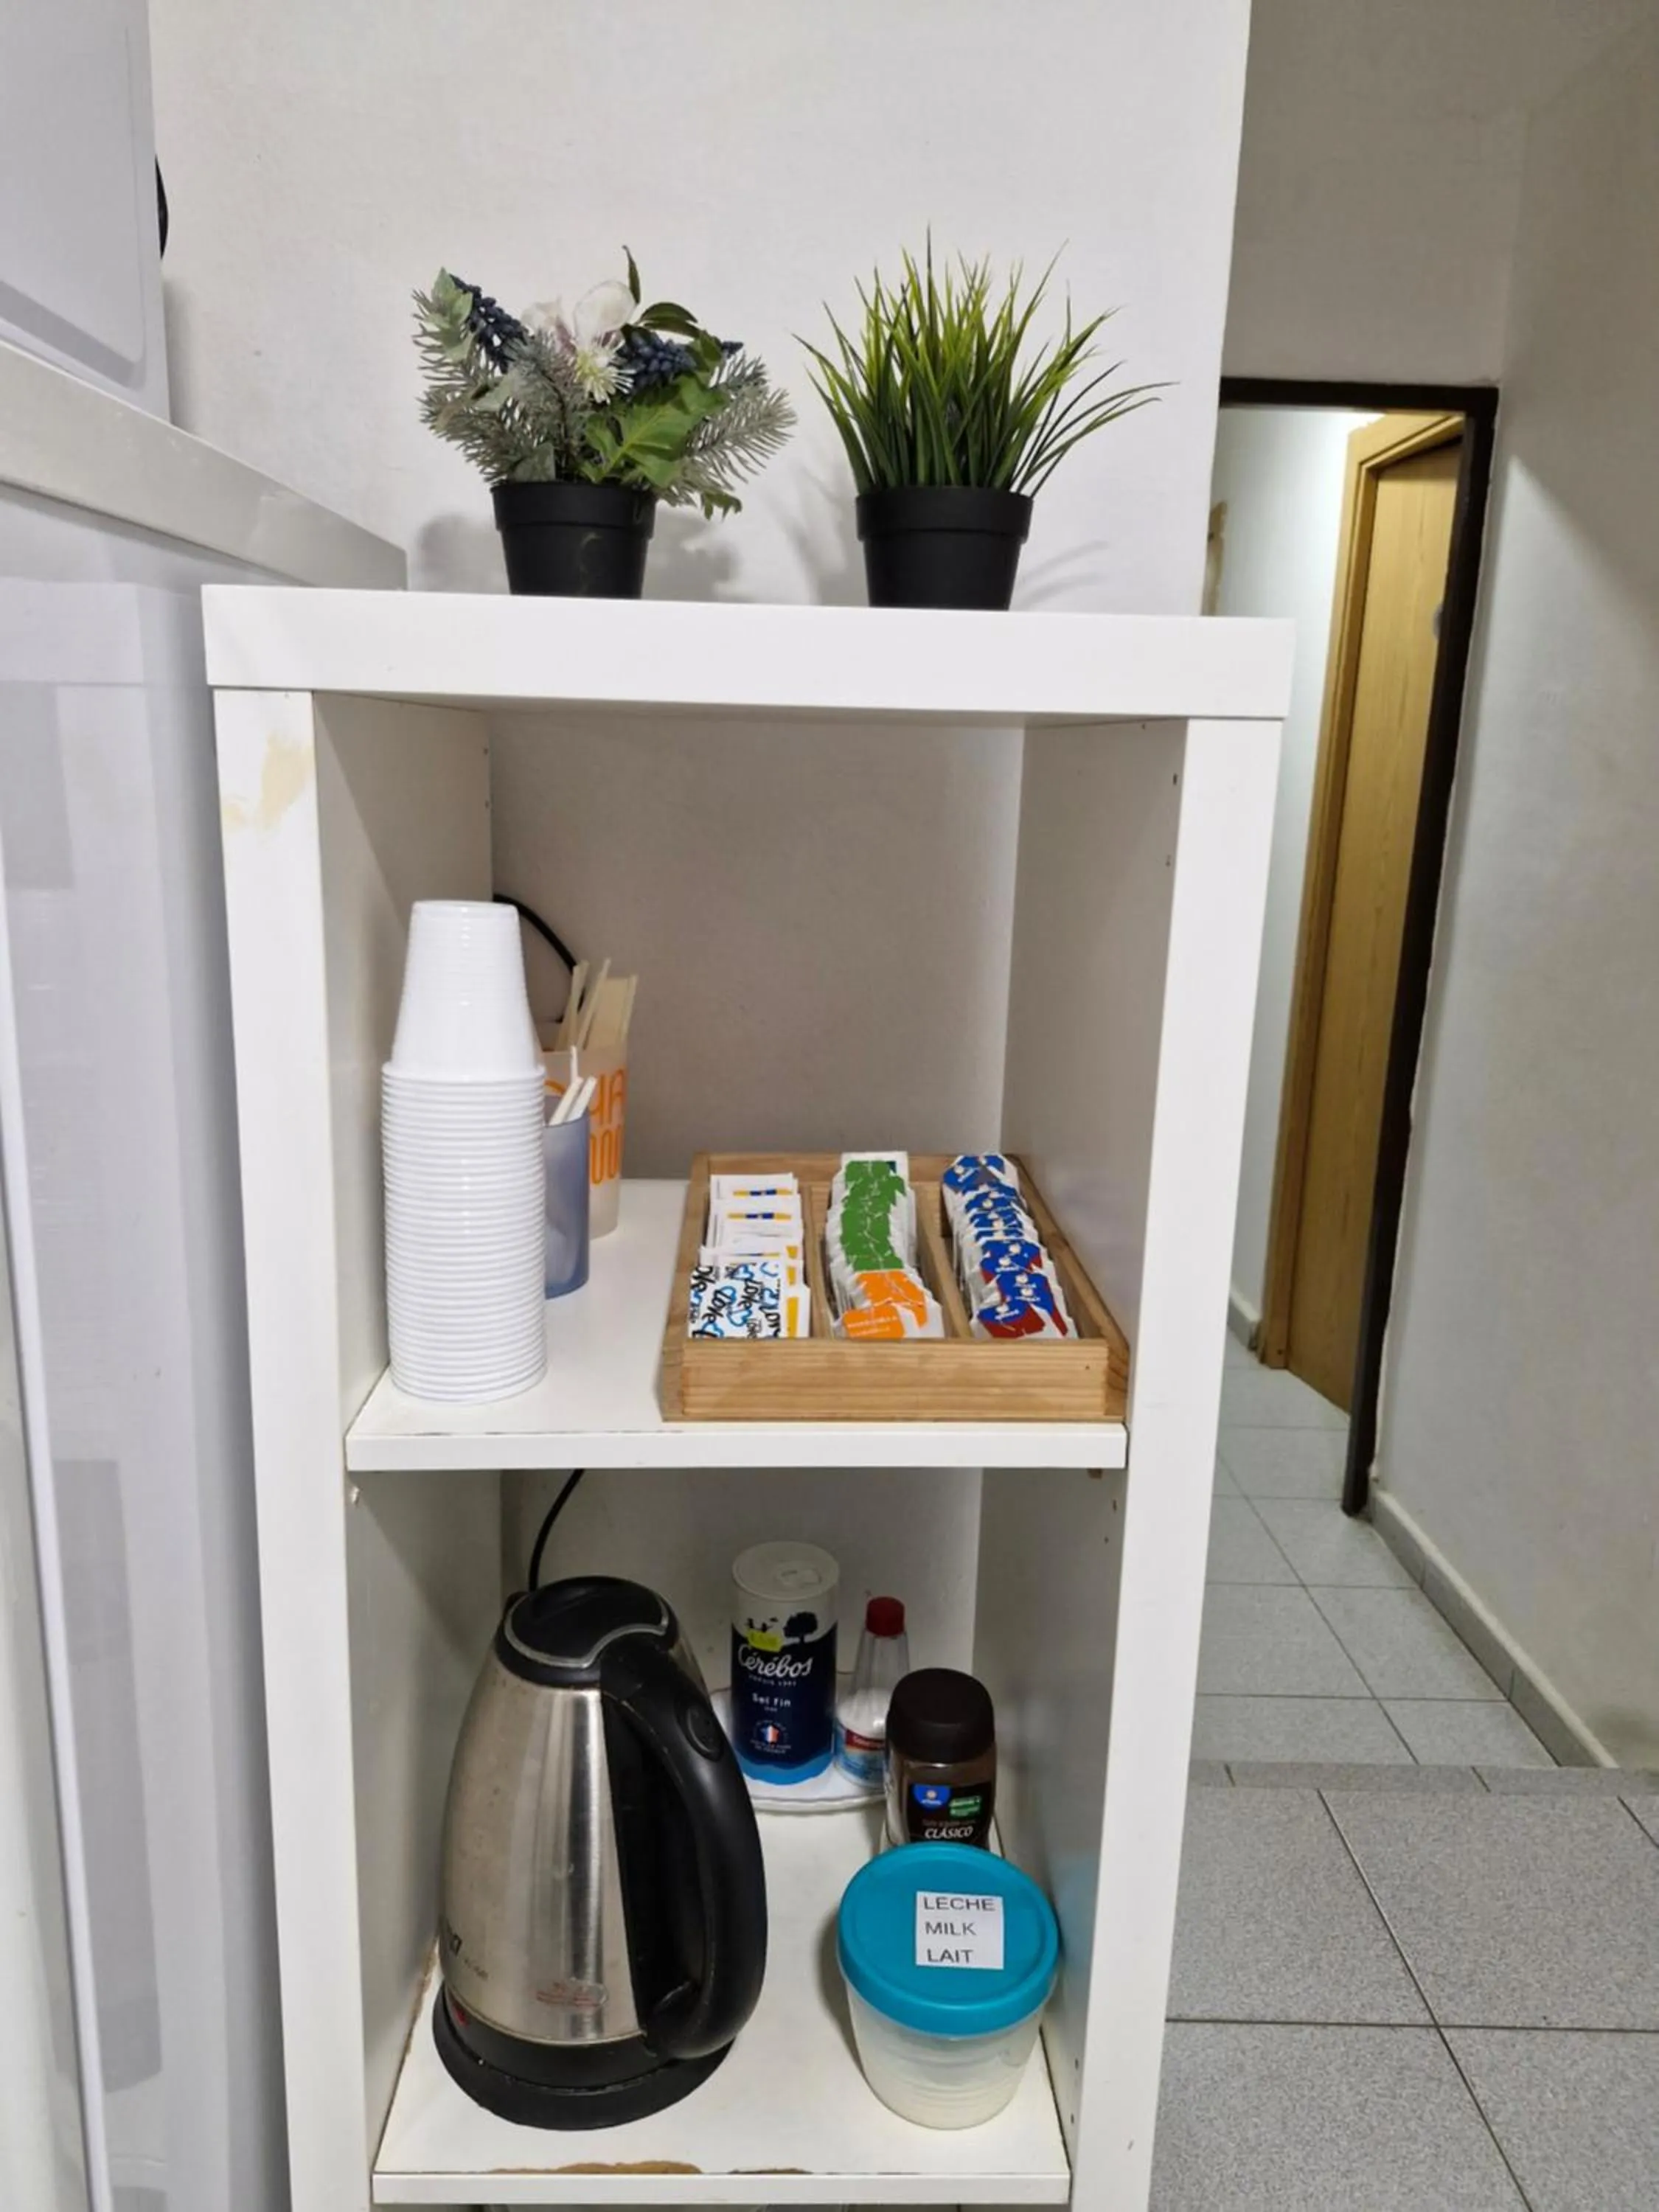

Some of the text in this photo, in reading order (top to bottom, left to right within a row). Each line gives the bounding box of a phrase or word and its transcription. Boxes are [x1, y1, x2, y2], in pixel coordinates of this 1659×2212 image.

[922, 1896, 996, 1912] LECHE
[925, 1921, 977, 1936] MILK
[926, 1947, 974, 1964] LAIT
